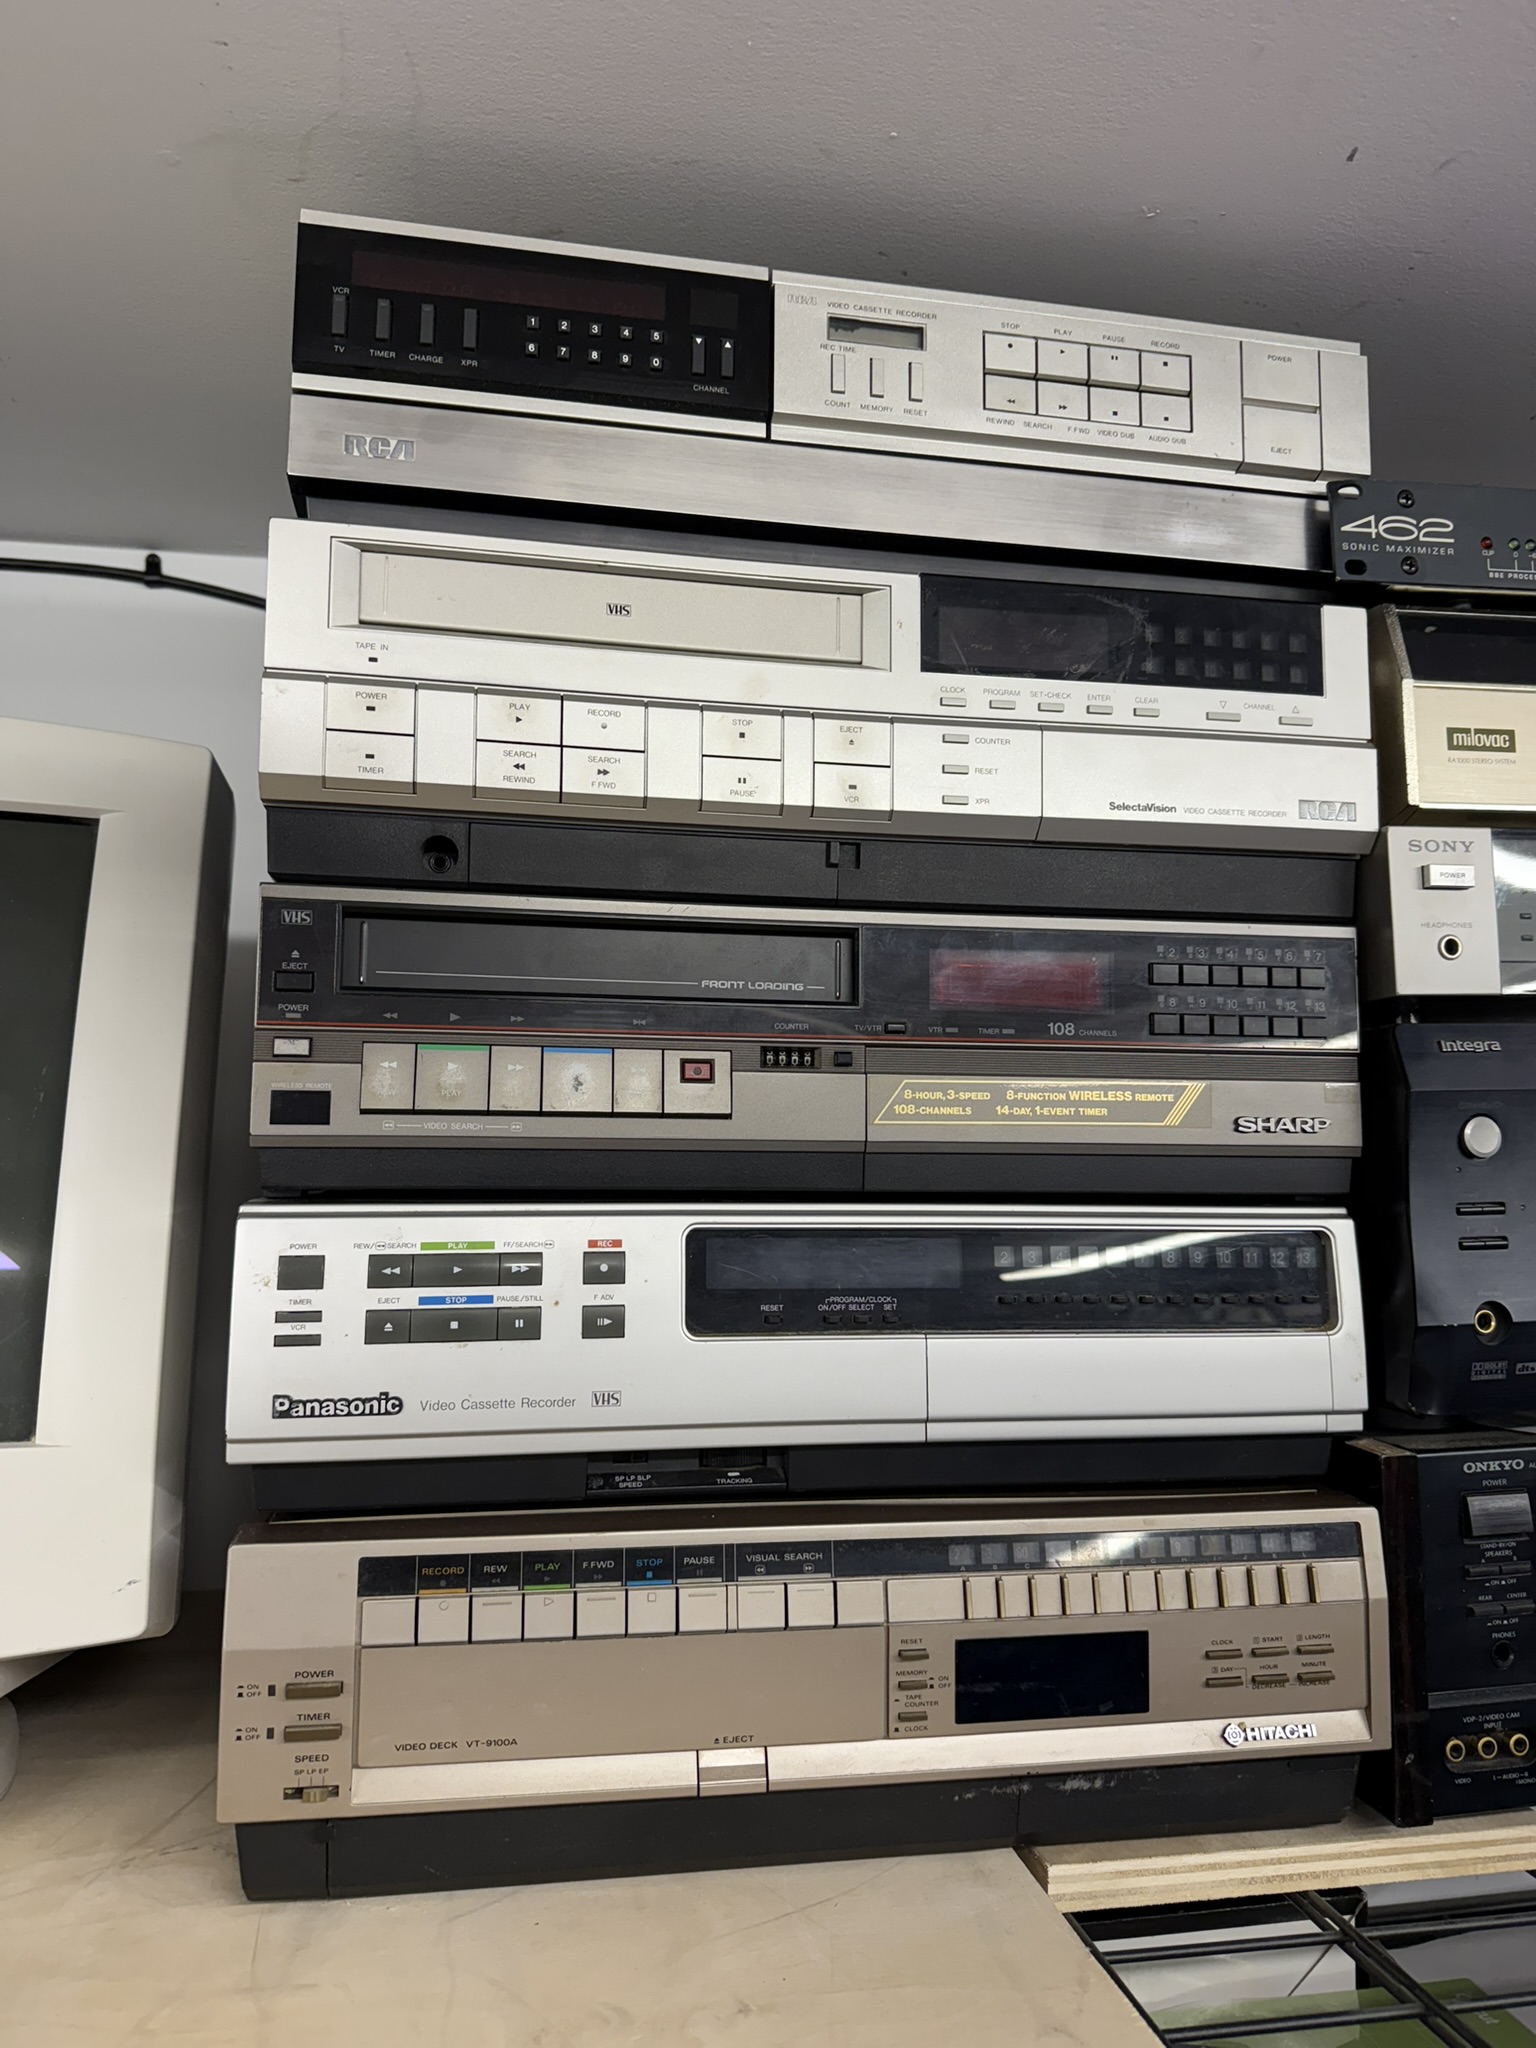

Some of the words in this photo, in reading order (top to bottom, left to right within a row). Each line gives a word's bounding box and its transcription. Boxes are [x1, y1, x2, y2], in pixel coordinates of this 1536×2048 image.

[332, 286, 350, 295] VCR
[827, 301, 850, 310] VIDEO
[853, 304, 892, 316] CASSETTE
[896, 310, 937, 320] RECORDER
[529, 317, 536, 327] 1
[560, 321, 568, 330] 2
[591, 324, 598, 334] 3
[623, 328, 630, 338] 4
[653, 332, 660, 341] 5
[1001, 322, 1020, 330] STOP
[1053, 328, 1072, 337] PLAY
[1102, 334, 1125, 344] PAUSE
[334, 344, 345, 354] TV
[819, 343, 836, 351] REC
[838, 345, 856, 353] TIME
[1150, 340, 1180, 350] RECORD
[369, 349, 396, 359] TIMER
[408, 353, 444, 364] CHARGE
[528, 343, 535, 353] 6
[560, 347, 567, 356] 7
[591, 350, 598, 360] 8
[622, 354, 629, 364] 9
[653, 357, 660, 367] 0
[1267, 354, 1292, 364] POWER
[460, 358, 478, 368] XPR
[693, 384, 730, 395] CHANNEL
[824, 400, 850, 409] COUNT
[860, 404, 893, 413] MEMORY
[903, 408, 927, 417] RESET
[986, 416, 1015, 426] REWIND
[1023, 421, 1053, 430] SEARCH
[1097, 428, 1118, 438] VIDEO
[1120, 431, 1135, 440] DUB
[1148, 434, 1170, 444] AUDIO
[1172, 437, 1186, 445] DUB
[343, 434, 416, 462] RCA
[1270, 446, 1292, 455] EJECT
[1340, 515, 1455, 543] 462
[1342, 542, 1379, 552] SONIC
[1386, 545, 1454, 555] MAXIMIZER
[608, 604, 630, 616] VHS
[355, 642, 376, 650] TAPE
[380, 643, 388, 651] IN
[940, 686, 966, 694] CLOCK
[982, 688, 1021, 697] PROGRAM
[355, 691, 388, 700] POWER
[1087, 694, 1111, 702] ENTER
[508, 702, 530, 712] PLAY
[1243, 702, 1275, 712] CHANNEL
[587, 709, 622, 718] RECORD
[732, 718, 753, 727] STOP
[839, 726, 863, 734] EJECT
[974, 736, 1011, 746] COUNTER
[1453, 728, 1509, 747] milovac
[502, 750, 537, 759] SEARCH
[587, 756, 621, 764] SEARCH
[357, 766, 384, 774] TIMER
[974, 767, 999, 776] RESET
[502, 775, 536, 784] REWIND
[730, 789, 755, 797] PAUSE
[975, 798, 990, 806] XPR
[1108, 801, 1177, 814] SelectaVision
[1298, 800, 1356, 822] RCA
[1183, 807, 1205, 816] VIDEO
[1207, 808, 1245, 817] CASSETTE
[1248, 809, 1287, 819] RECORDER
[1408, 840, 1474, 853] SONY
[283, 910, 312, 924] VHS
[1169, 948, 1175, 956] 2
[1198, 950, 1205, 958] 3
[1228, 950, 1234, 958] 4
[1258, 951, 1264, 960] 5
[1286, 952, 1292, 960] 6
[1315, 953, 1321, 961] 7
[282, 961, 308, 970] EJECT
[701, 980, 745, 989] FRONT
[748, 982, 804, 991] LOADING
[278, 1003, 309, 1012] POWER
[1169, 998, 1175, 1006] 8
[1200, 999, 1206, 1007] 9
[1227, 1000, 1237, 1008] 10
[1258, 1001, 1266, 1009] 11
[1285, 1001, 1296, 1010] 12
[1314, 1002, 1325, 1011] 13
[774, 1022, 809, 1031] COUNTER
[854, 1024, 882, 1032] TV/VTR
[927, 1026, 943, 1034] VTR
[978, 1027, 1000, 1035] TIMER
[1047, 1022, 1075, 1036] 108
[1078, 1028, 1117, 1038] CHANNELS
[1439, 1039, 1501, 1053] Integra
[946, 1089, 991, 1100] 3-SPEED
[1006, 1090, 1066, 1101] 8-FUNCTION
[1068, 1090, 1132, 1102] WIRELESS
[1135, 1093, 1174, 1102] REMOTE
[893, 1105, 972, 1115] 108-CHANNELS
[1034, 1106, 1076, 1116] 1-EVENT
[1078, 1108, 1108, 1116] TIMER
[423, 1121, 447, 1130] VIDEO
[450, 1122, 483, 1131] SEARCH
[1232, 1116, 1332, 1134] SHARP
[447, 1242, 468, 1250] PLAY
[503, 1240, 544, 1249] FF/SEARCH
[597, 1240, 613, 1248] REC
[445, 1296, 467, 1304] STOP
[593, 1391, 620, 1406] VHS
[273, 1392, 403, 1419] Panasonic
[420, 1398, 456, 1411] Video
[460, 1398, 516, 1411] Cassette
[520, 1397, 576, 1410] Recorder
[1463, 1459, 1524, 1473] ONKYO
[683, 1555, 715, 1566] PAUSE
[745, 1552, 781, 1563] VISUAL
[783, 1551, 823, 1562] SEARCH
[534, 1561, 561, 1572] PLAY
[635, 1557, 663, 1568] STOP
[421, 1565, 465, 1576] RECORD
[483, 1564, 508, 1574] REW
[294, 1670, 334, 1678] POWER
[296, 1712, 330, 1721] TIMER
[1246, 1724, 1317, 1741] HITACHI
[394, 1741, 427, 1752] VIDEO
[430, 1739, 458, 1751] DECK
[466, 1737, 518, 1749] VT-9100A
[722, 1734, 754, 1745] EJECT
[294, 1754, 329, 1763] SPEED
